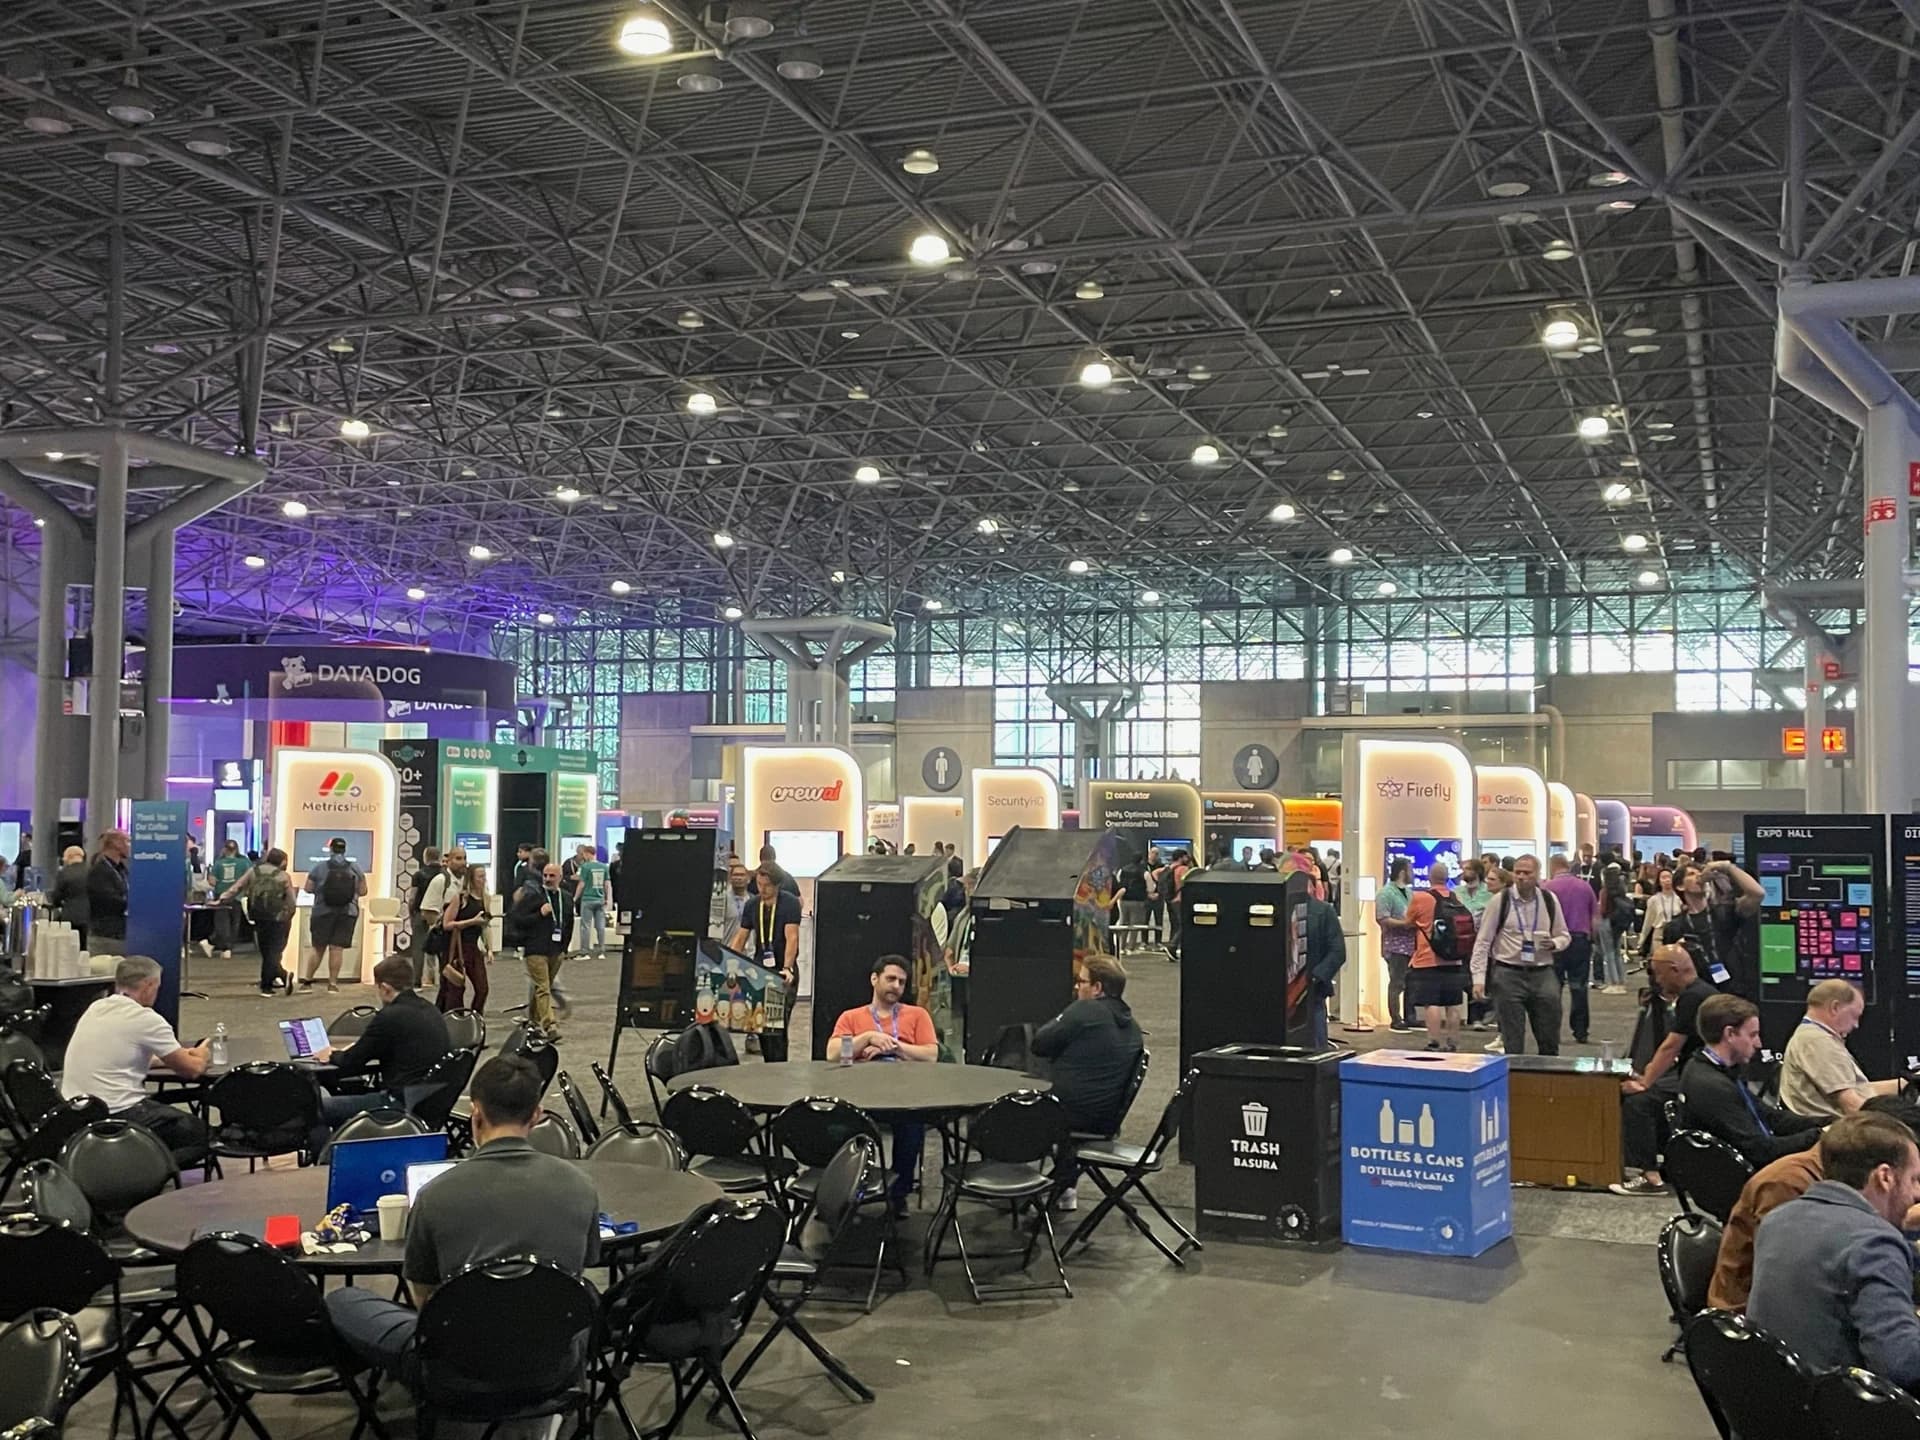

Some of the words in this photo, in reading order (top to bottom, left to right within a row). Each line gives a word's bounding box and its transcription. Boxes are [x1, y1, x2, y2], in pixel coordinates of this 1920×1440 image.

[318, 665, 421, 684] DATADOG
[1114, 792, 1150, 800] conduktor
[1407, 782, 1451, 801] Firefly
[302, 801, 377, 813] MetricsHub
[1757, 829, 1782, 838] EXPO
[1787, 829, 1814, 838] HALL
[1230, 1140, 1280, 1156] TRASH
[1233, 1157, 1278, 1170] BASURA
[1351, 1146, 1411, 1163] BOTTLES
[1413, 1152, 1423, 1164] &
[1425, 1154, 1464, 1168] CANS
[1360, 1165, 1412, 1178] BOTELLAS
[1414, 1170, 1422, 1179] Y
[1423, 1171, 1455, 1183] LATAS
